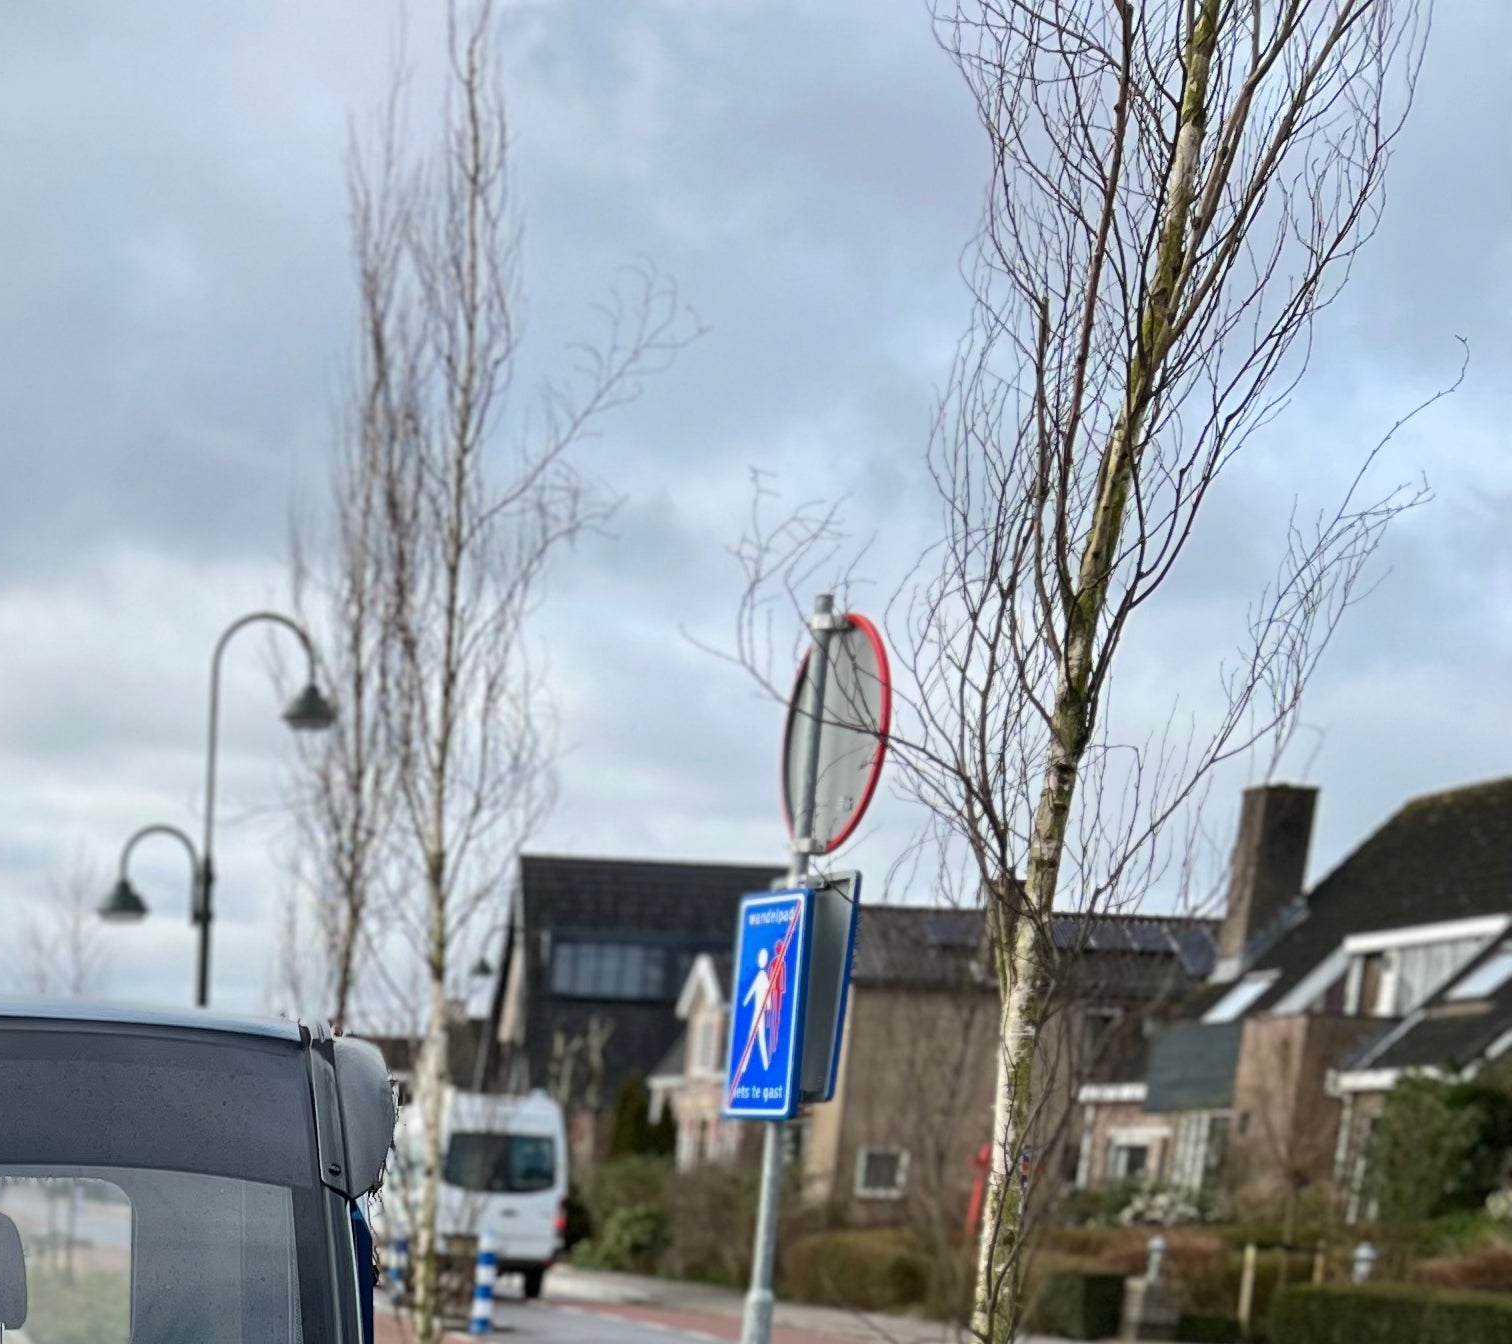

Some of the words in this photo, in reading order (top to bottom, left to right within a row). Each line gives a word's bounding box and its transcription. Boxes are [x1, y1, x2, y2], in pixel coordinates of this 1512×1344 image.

[731, 1085, 750, 1099] ets
[752, 1085, 761, 1099] te
[763, 1085, 783, 1103] gast
